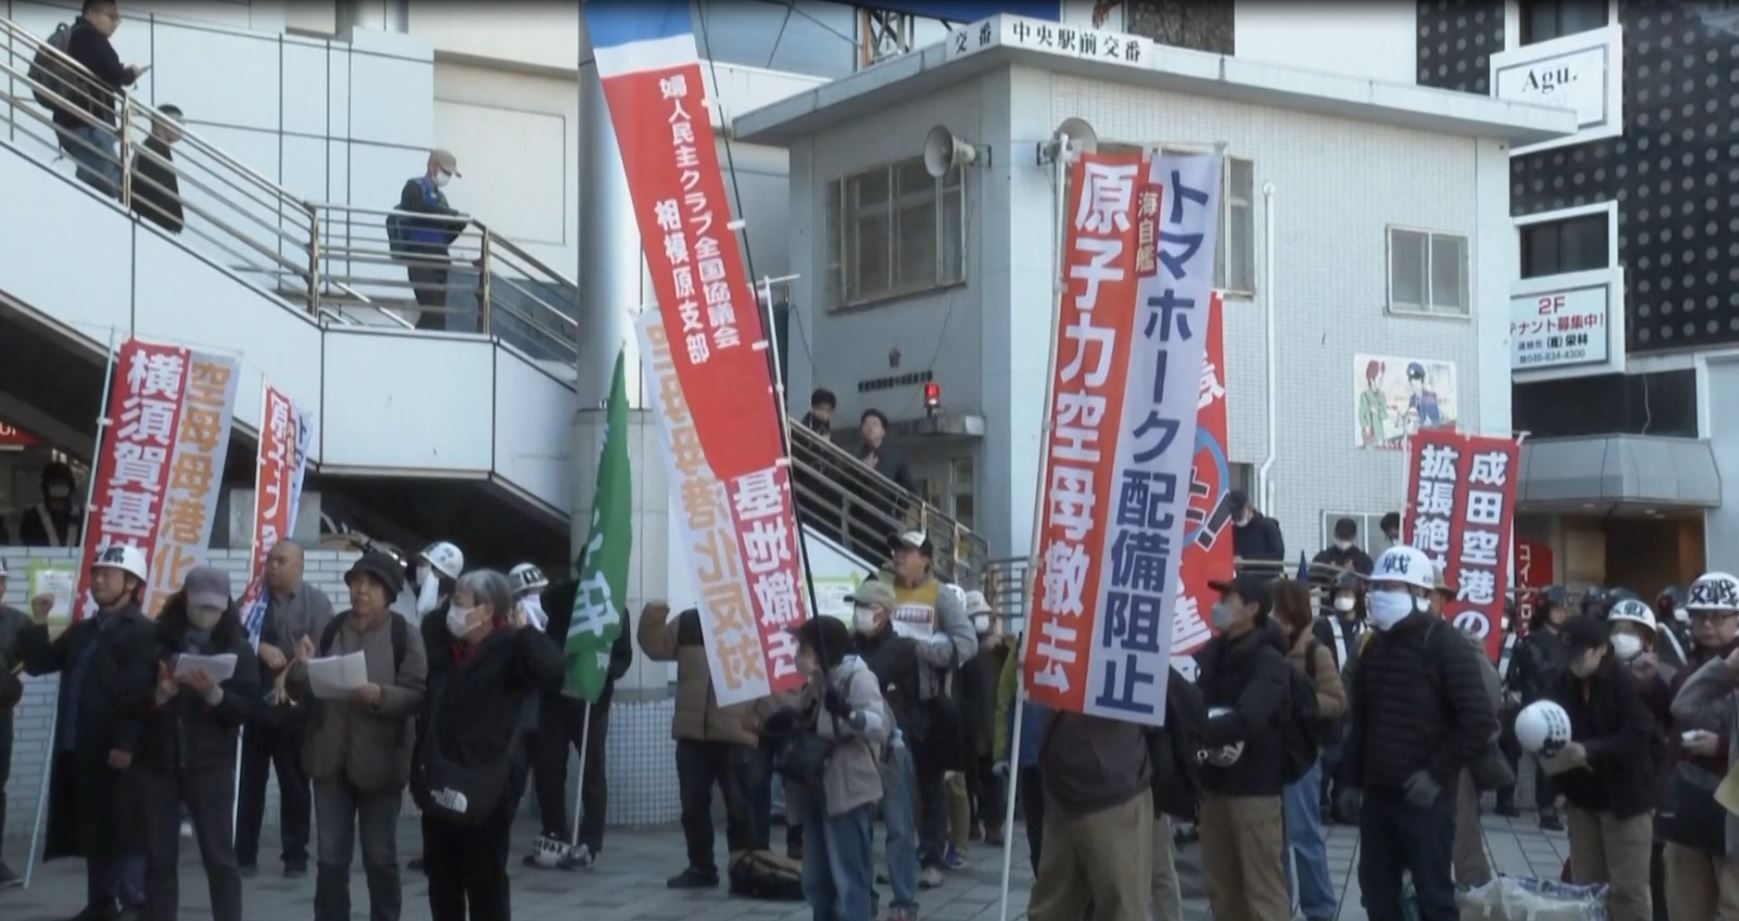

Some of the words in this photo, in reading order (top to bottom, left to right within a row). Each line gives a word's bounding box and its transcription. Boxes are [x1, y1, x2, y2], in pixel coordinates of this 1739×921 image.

[955, 22, 993, 54] 交番
[1013, 20, 1142, 62] 中央駅前交番
[1522, 67, 1577, 94] Agu.
[654, 198, 710, 365] 相模原支部
[1538, 295, 1566, 316] 2F
[86, 349, 184, 624] 横須賀基
[1033, 161, 1139, 695] 原子力空母撤去
[1095, 170, 1209, 714] トマホーク配備阻止
[1451, 451, 1509, 638] 成田空港の
